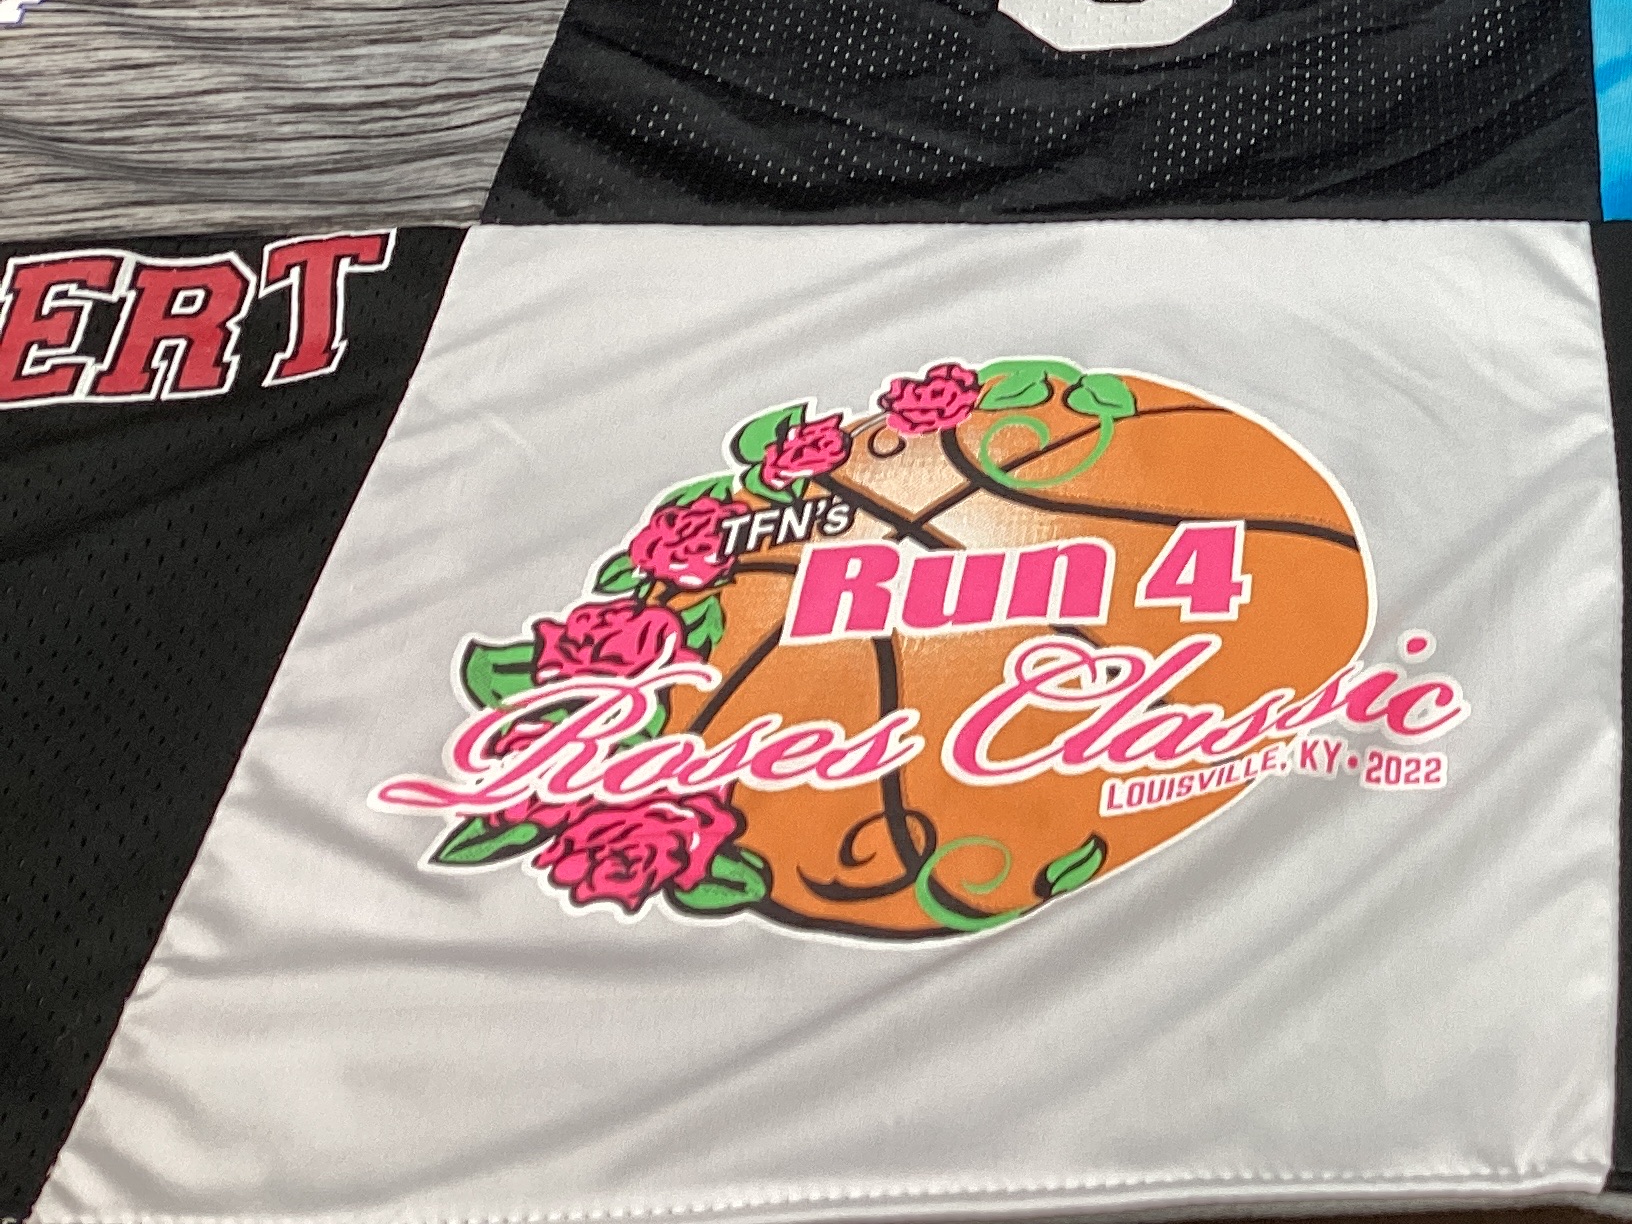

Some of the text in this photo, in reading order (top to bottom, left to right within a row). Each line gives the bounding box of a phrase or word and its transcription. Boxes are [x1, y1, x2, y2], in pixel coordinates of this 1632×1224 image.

[719, 494, 857, 565] TFN's
[780, 519, 1252, 646] Run 4
[366, 626, 1473, 818] Roses Classic
[1106, 738, 1444, 812] LOUISVILLE, KY 2022
